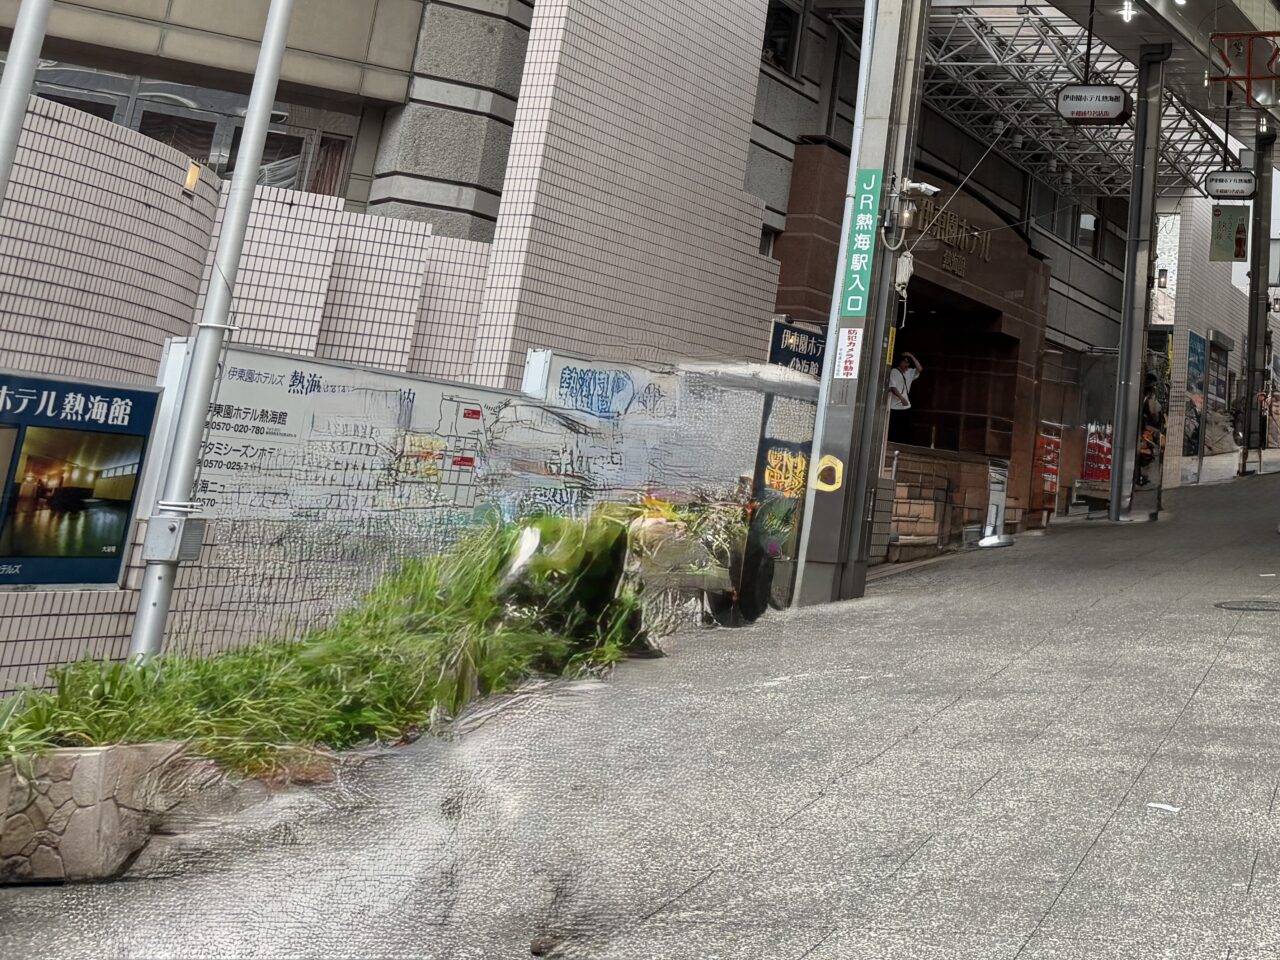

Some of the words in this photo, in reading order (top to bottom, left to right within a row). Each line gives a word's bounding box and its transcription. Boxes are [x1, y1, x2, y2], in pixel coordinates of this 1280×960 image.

[846, 173, 876, 312] JR熱海駅入口
[228, 366, 286, 387] 伊東園ホテルズ
[211, 421, 265, 435] 0570-020-780
